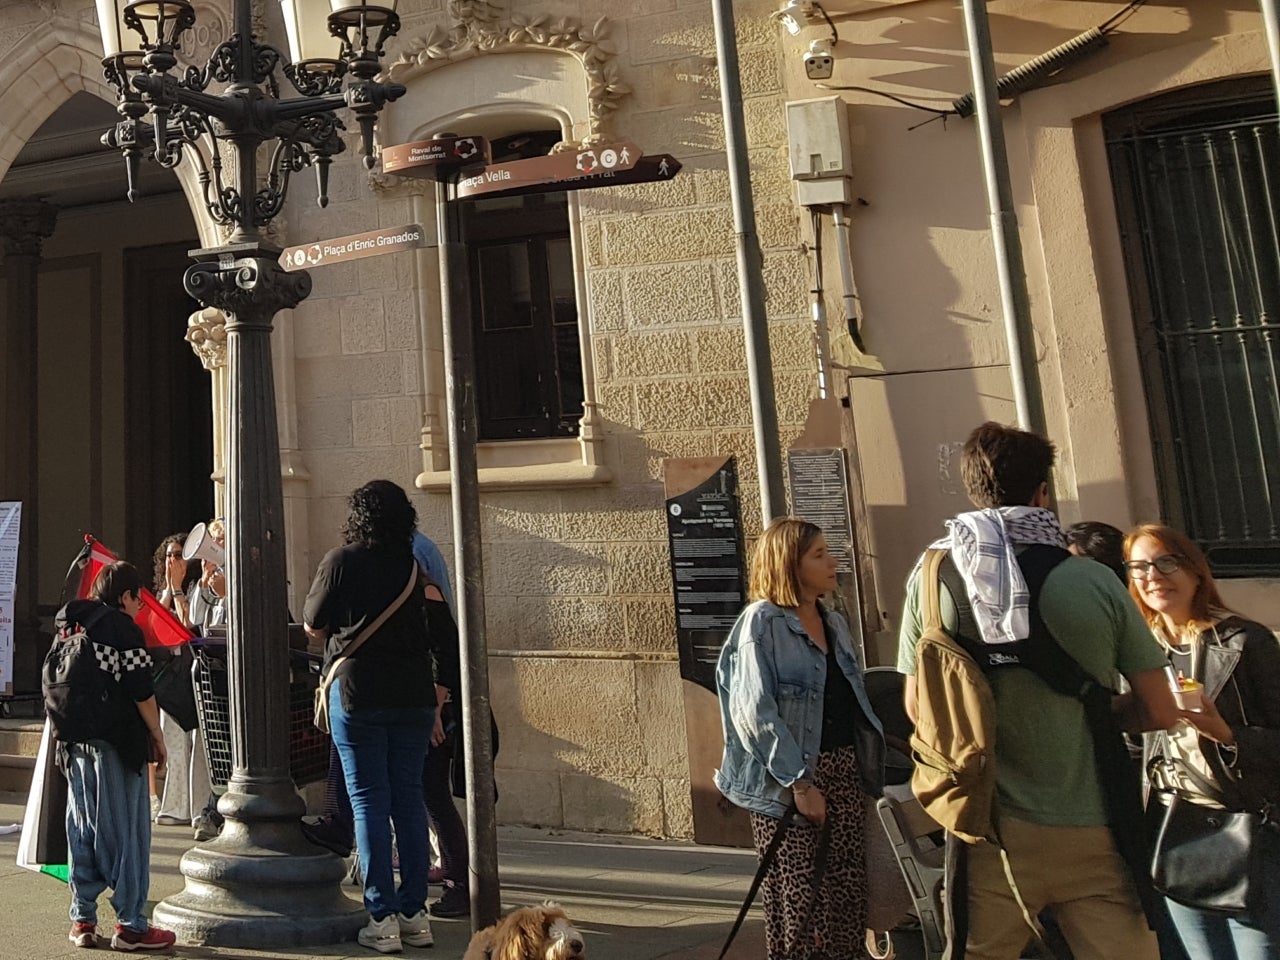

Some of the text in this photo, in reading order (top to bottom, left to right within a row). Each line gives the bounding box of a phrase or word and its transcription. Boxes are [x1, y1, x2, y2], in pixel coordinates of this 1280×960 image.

[411, 146, 431, 155] Raval
[408, 152, 447, 162] Montserrat
[485, 170, 511, 182] Vella
[324, 246, 346, 257] Plaça
[347, 239, 375, 252] d'Enric
[376, 231, 420, 246] Granados
